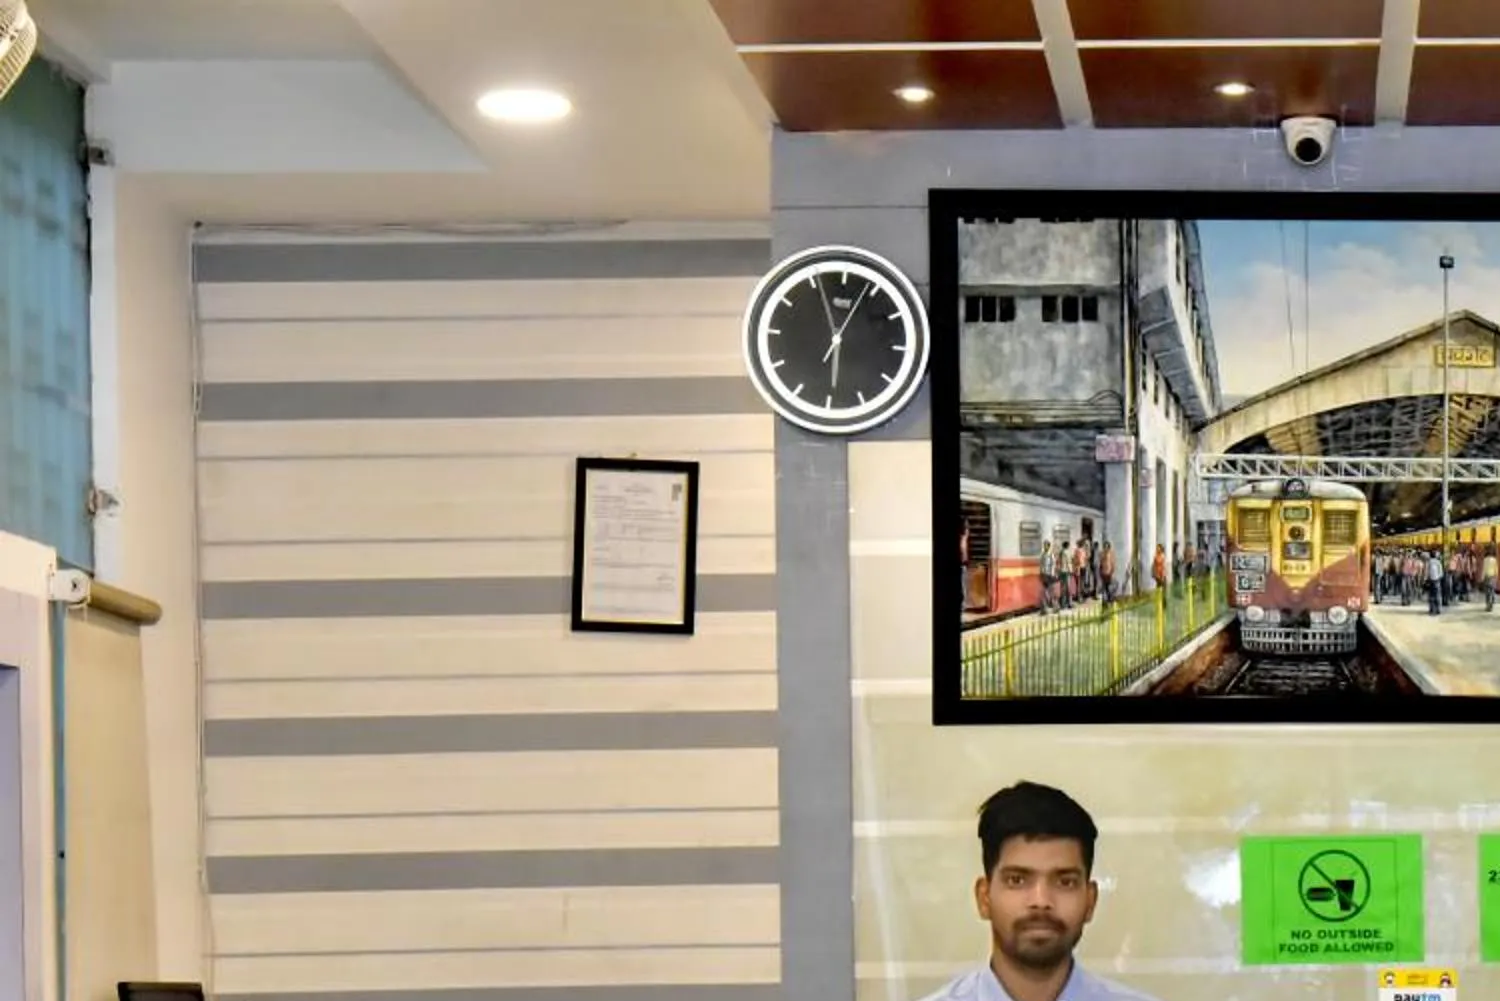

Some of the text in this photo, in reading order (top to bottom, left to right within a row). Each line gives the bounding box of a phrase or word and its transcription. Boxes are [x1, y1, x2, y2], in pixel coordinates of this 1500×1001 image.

[1290, 928, 1382, 940] NO OUTSIDE
[1279, 941, 1395, 953] FOOD ALLOWED
